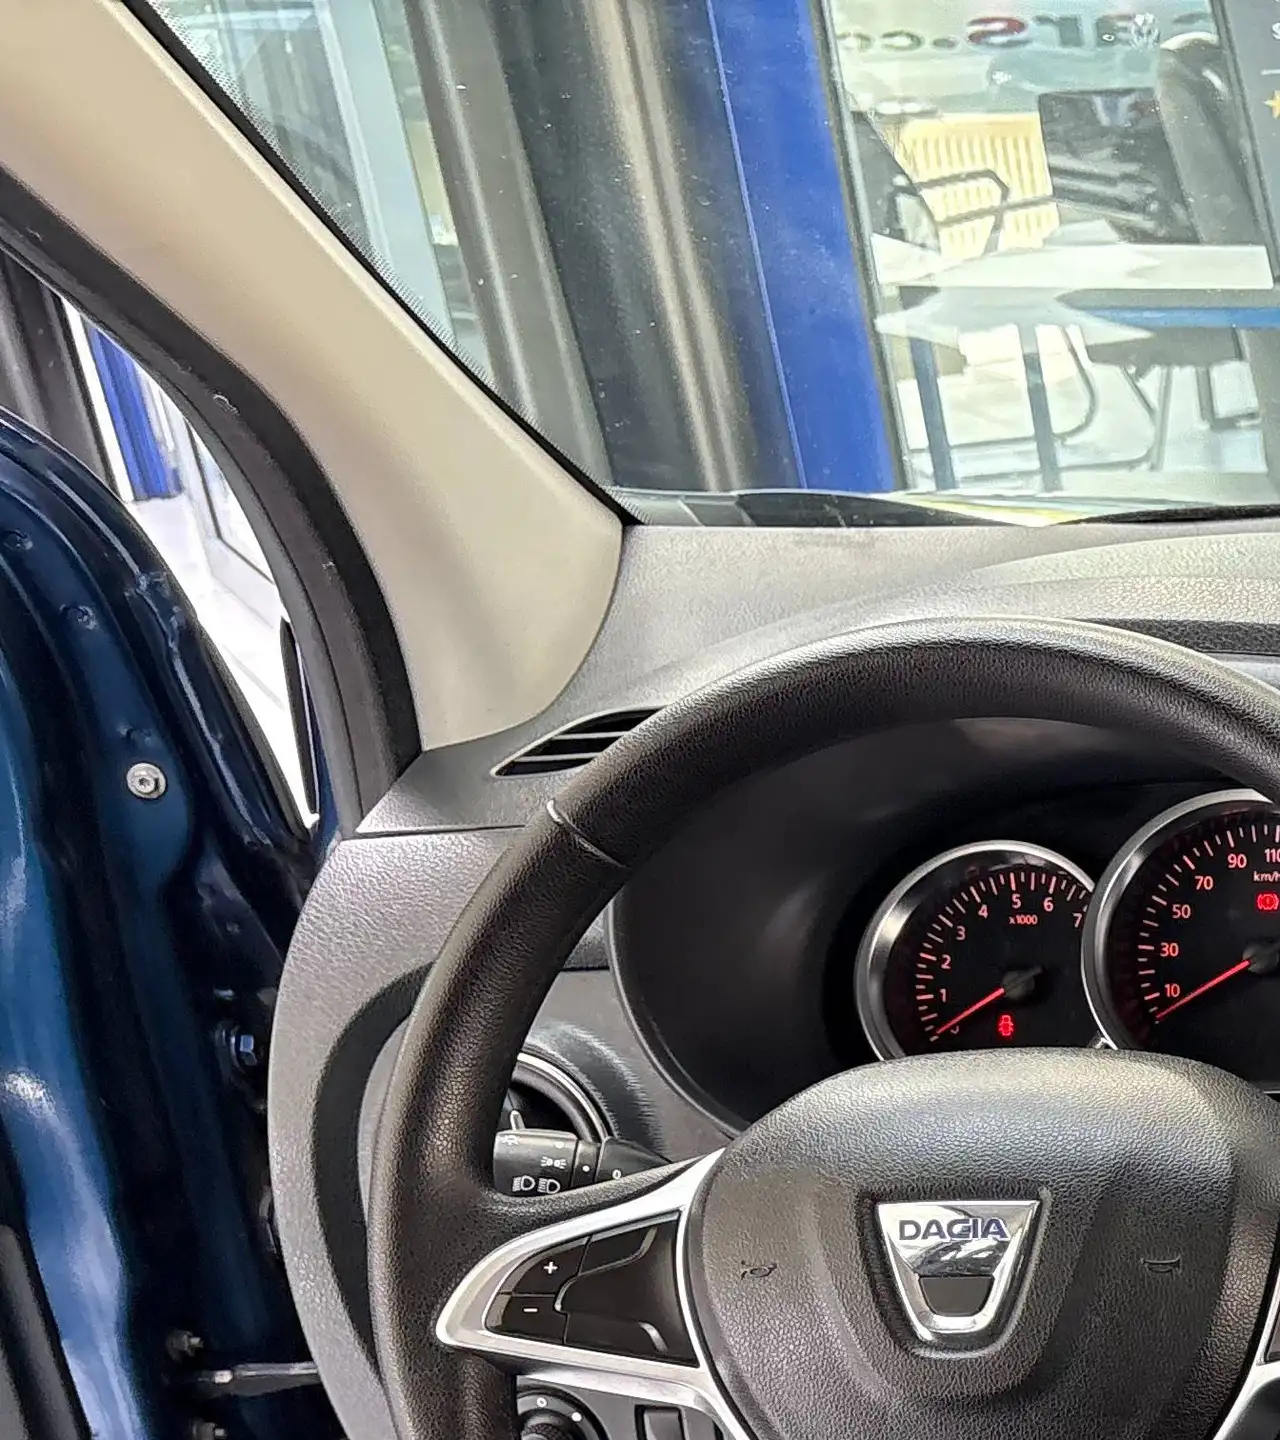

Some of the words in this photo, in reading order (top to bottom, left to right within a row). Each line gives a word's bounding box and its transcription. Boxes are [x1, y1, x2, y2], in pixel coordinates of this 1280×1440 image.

[1227, 853, 1247, 869] 90
[1195, 875, 1213, 891] 70
[1011, 894, 1022, 909] 5
[1043, 897, 1054, 913] 6
[978, 904, 989, 919] 4
[1171, 904, 1191, 919] 50
[1072, 913, 1083, 928] 7
[956, 926, 966, 941] 3
[1160, 942, 1179, 958] 30
[940, 954, 952, 970] 2
[939, 989, 947, 1002] 1
[1164, 983, 1181, 998] 10
